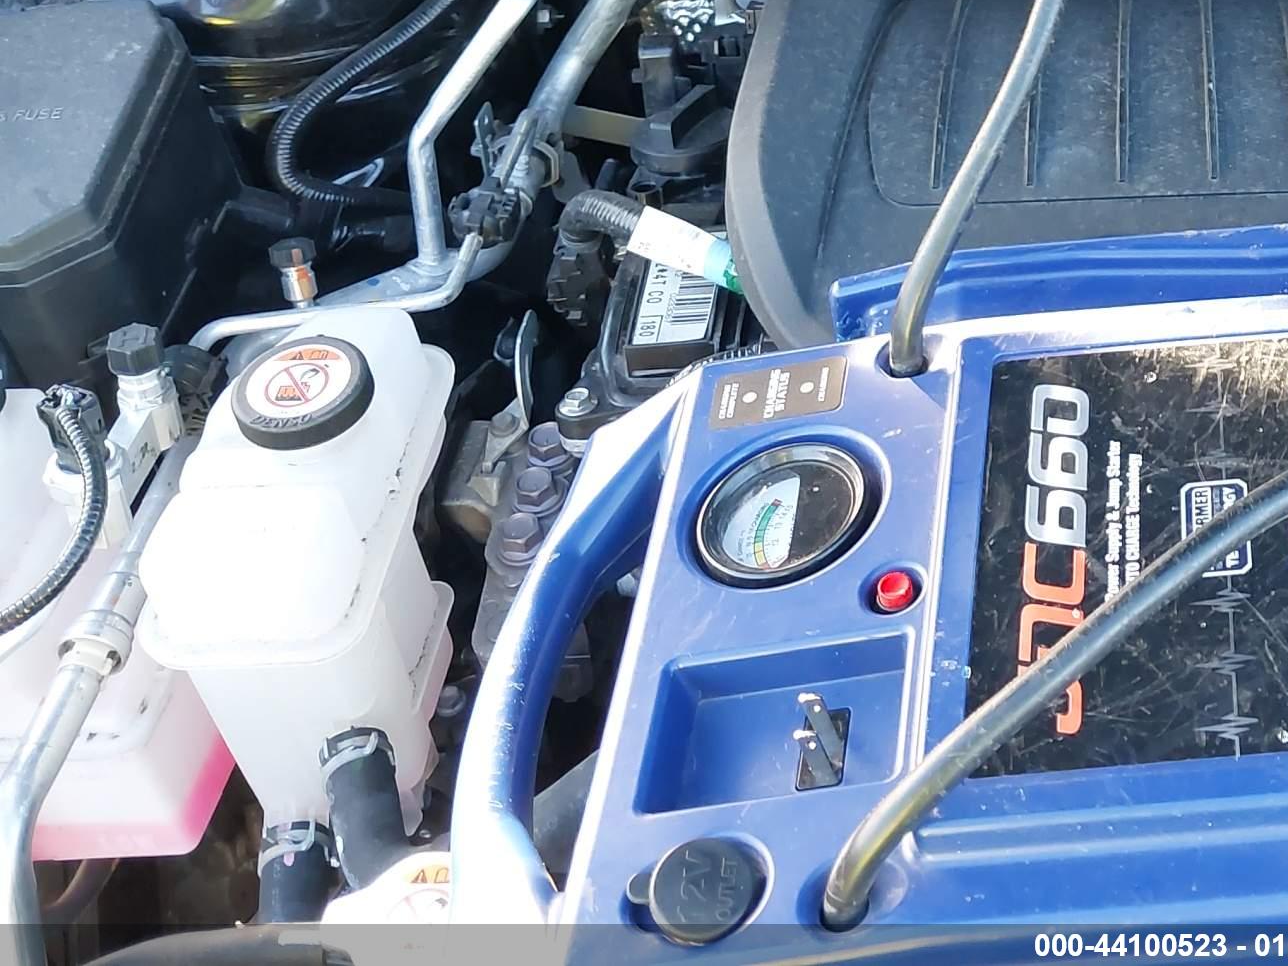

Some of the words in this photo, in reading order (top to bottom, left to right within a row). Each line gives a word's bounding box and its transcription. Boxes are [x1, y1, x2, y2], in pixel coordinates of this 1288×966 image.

[13, 106, 65, 122] FUSE
[638, 320, 657, 337] 180
[774, 371, 791, 412] STATUS
[249, 412, 313, 429] DENSO
[1106, 441, 1121, 477] Starter
[1106, 478, 1123, 509] Jump
[1126, 453, 1142, 515] Technology
[1105, 510, 1120, 521] &
[1104, 522, 1122, 562] Supply
[1125, 515, 1140, 561] CHARGE
[1104, 563, 1120, 602] Power
[676, 849, 712, 923] 12V
[714, 857, 738, 922] OUTLET
